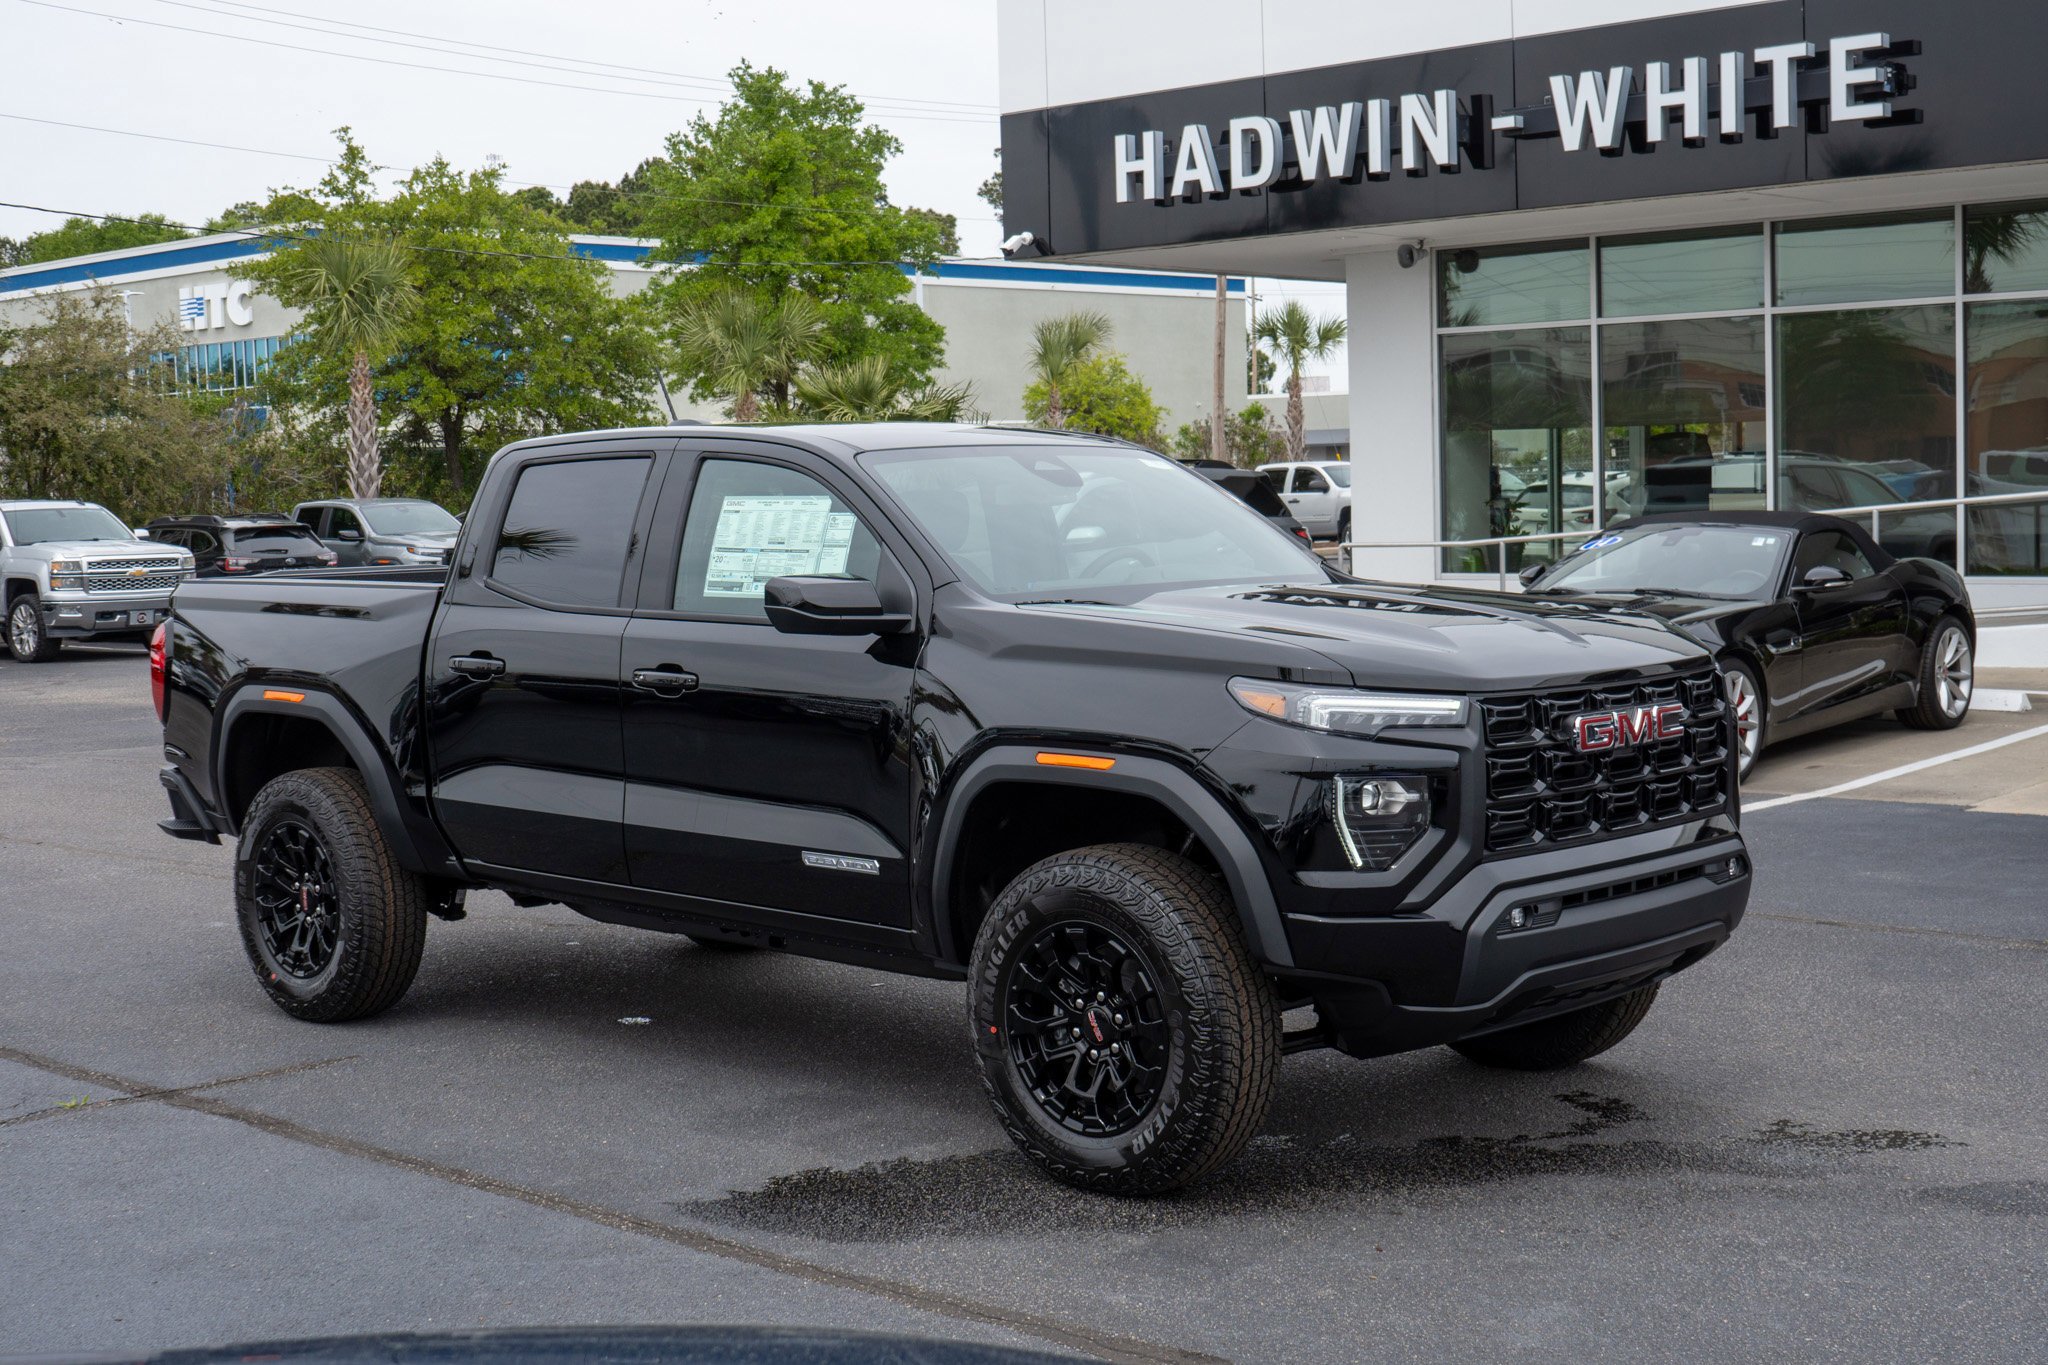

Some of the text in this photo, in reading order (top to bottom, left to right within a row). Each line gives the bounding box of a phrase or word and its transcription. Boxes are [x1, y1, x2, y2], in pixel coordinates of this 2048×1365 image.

[1115, 89, 1457, 203] HADWIN
[1549, 32, 1891, 151] WHITE
[1575, 702, 1686, 752] GMC
